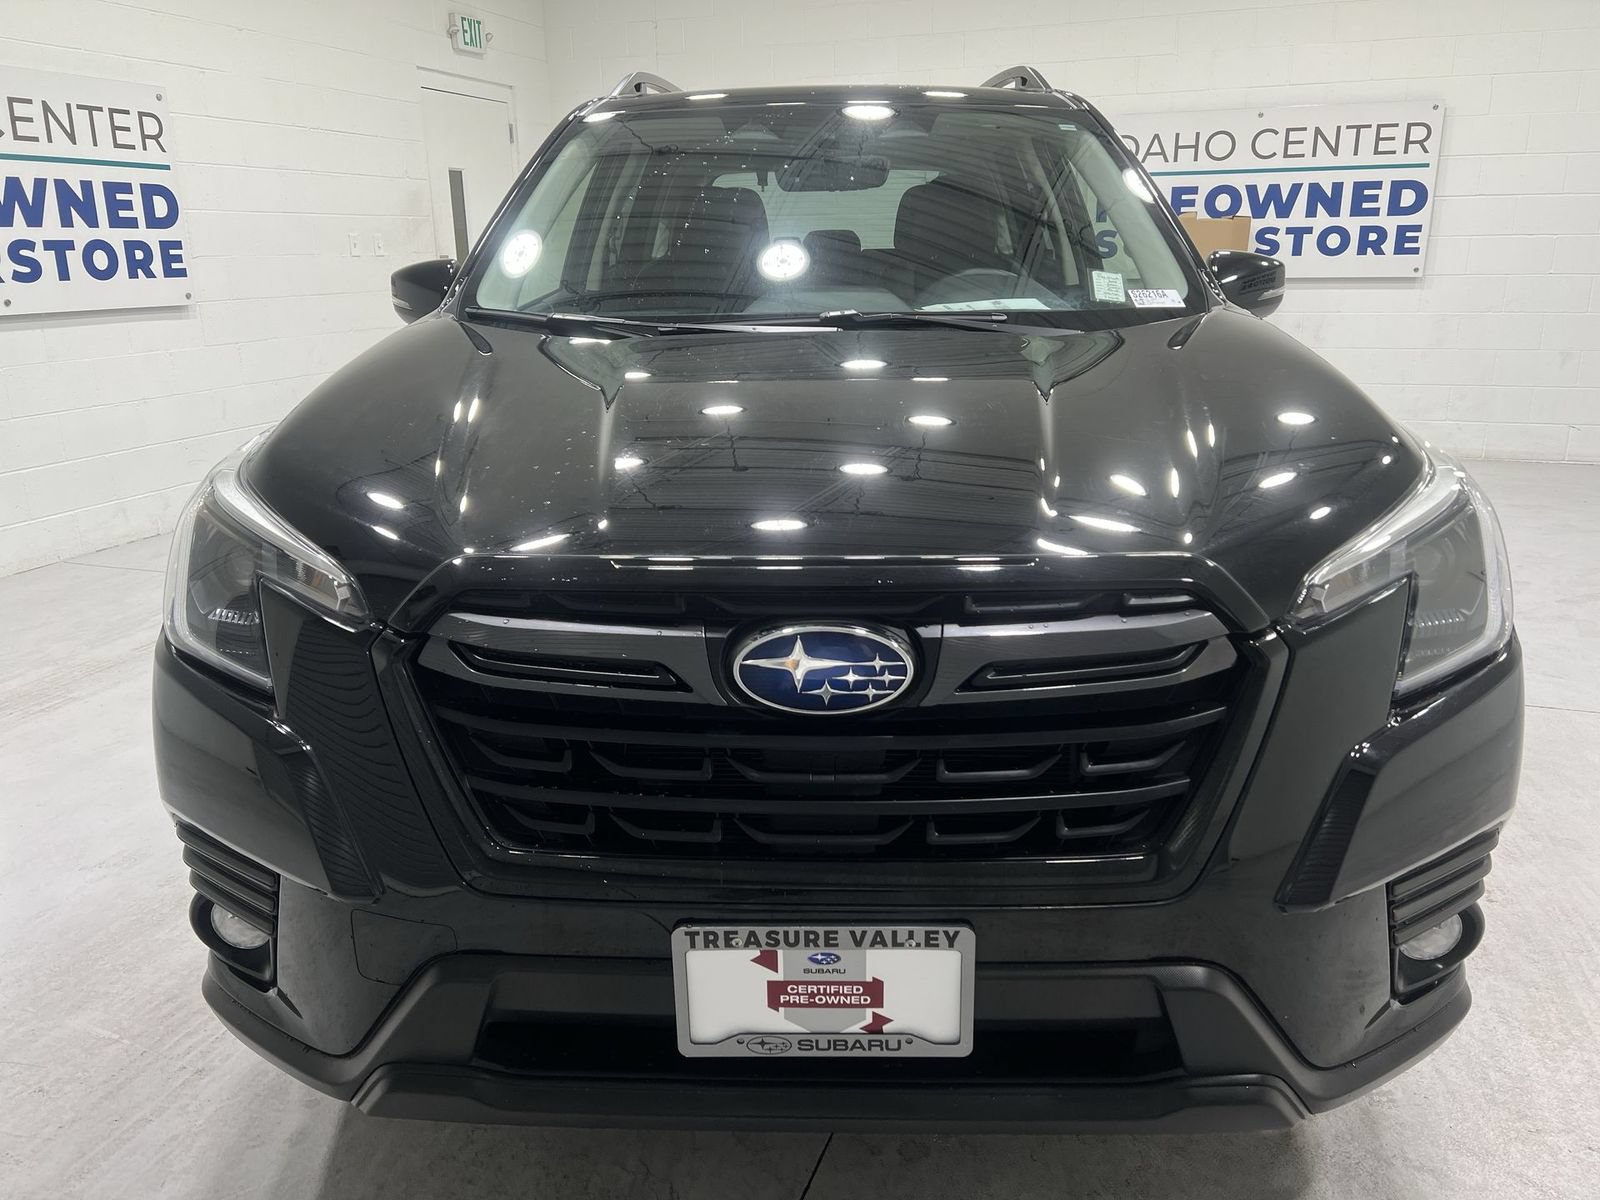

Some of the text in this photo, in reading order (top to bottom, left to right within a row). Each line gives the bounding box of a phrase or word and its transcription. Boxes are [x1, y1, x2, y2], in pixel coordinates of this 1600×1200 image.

[460, 16, 482, 49] EXIT
[0, 96, 167, 153] ENTER
[1250, 122, 1433, 160] CENTER
[1253, 223, 1424, 257] STORE
[0, 238, 189, 284] STORE
[684, 929, 961, 949] TREASURE VALLEY
[803, 967, 847, 975] SUBARU
[779, 994, 872, 1005] PRE-OWNED
[786, 984, 864, 994] CERTIFIED
[796, 1038, 902, 1052] SUBARU
